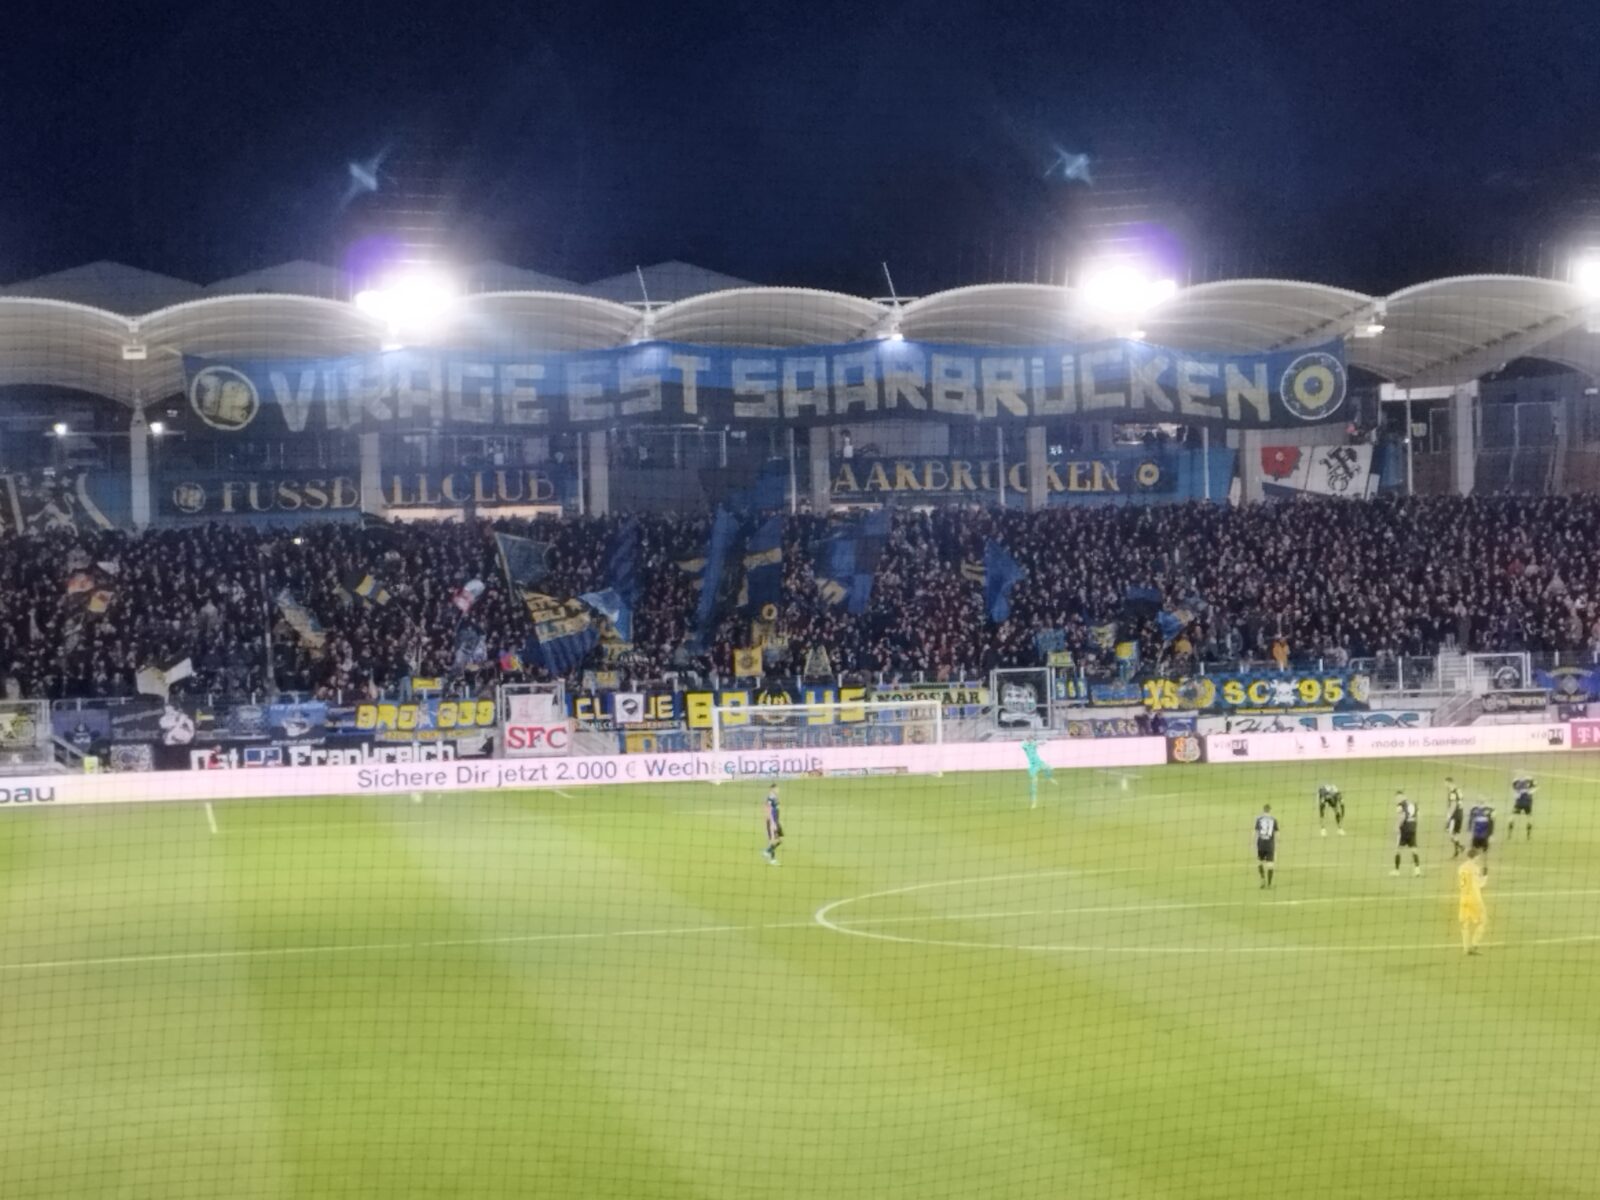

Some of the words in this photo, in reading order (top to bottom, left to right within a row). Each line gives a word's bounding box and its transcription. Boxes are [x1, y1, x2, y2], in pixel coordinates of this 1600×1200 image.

[269, 362, 549, 432] VIRAGE
[567, 354, 711, 422] EST
[732, 350, 1270, 422] SAARBRÜCKEN
[222, 468, 556, 513] FUSSBLLCLUB
[1223, 680, 1271, 704] SC
[1299, 679, 1344, 703] 95
[507, 726, 567, 749] SFC
[289, 741, 456, 767] Frankreich
[357, 768, 447, 788] Sichere
[456, 766, 490, 784] Dir
[497, 764, 548, 787] jetzt
[556, 761, 617, 781] 2.000
[644, 756, 823, 777] Wechelprämie
